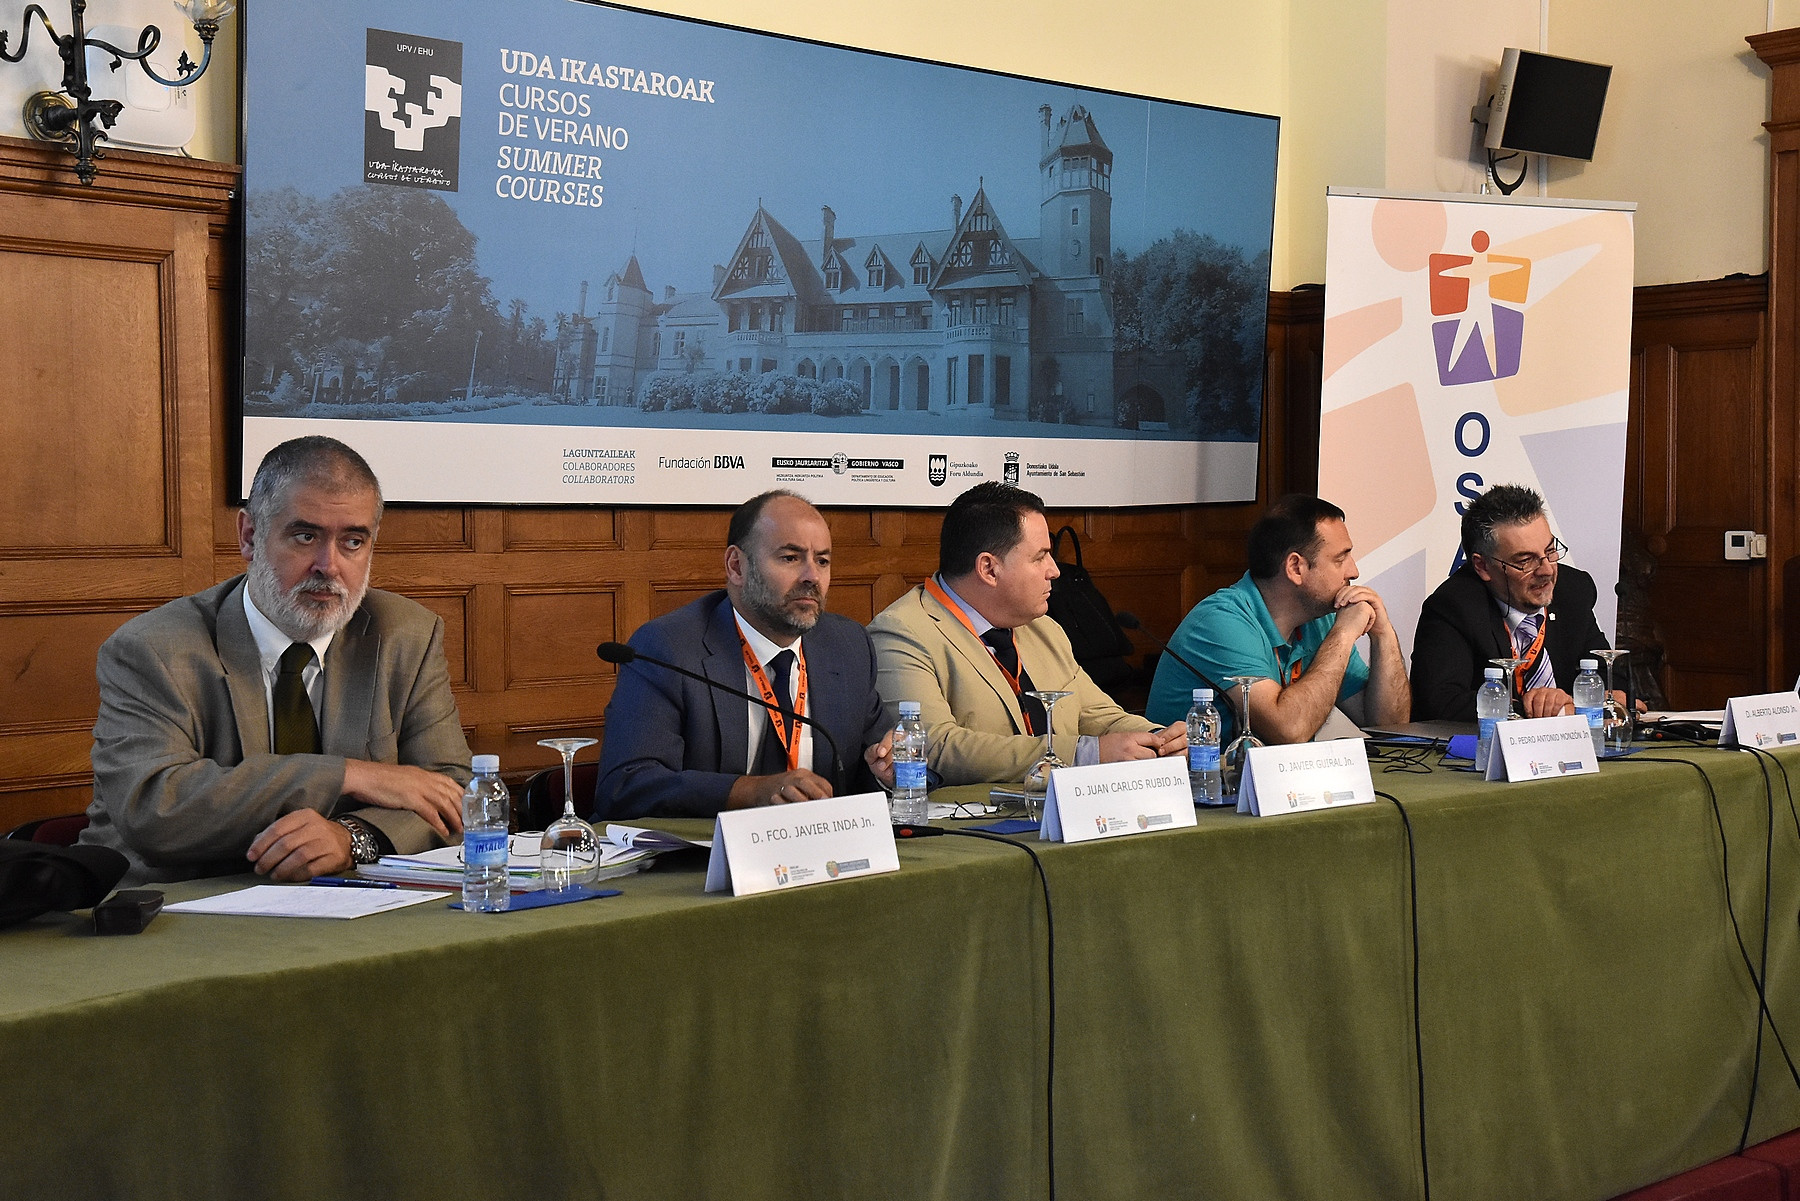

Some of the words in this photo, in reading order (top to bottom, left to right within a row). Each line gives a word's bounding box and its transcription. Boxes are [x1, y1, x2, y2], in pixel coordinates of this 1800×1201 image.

[396, 44, 412, 54] UPV
[417, 46, 435, 57] EHU
[501, 48, 556, 80] UDA
[560, 58, 715, 103] IKASTAROAK
[499, 83, 591, 117] CURSOS
[1496, 84, 1507, 112] BOSCH
[498, 112, 530, 138] DE
[534, 116, 629, 150] VERANO
[497, 146, 602, 180] SUMMER
[496, 175, 604, 208] COURSES
[562, 449, 636, 459] LAGUNTZAILEAK
[562, 462, 636, 472] COLABORADORES
[659, 456, 711, 469] Fundación
[713, 455, 745, 469] BBVA
[795, 459, 829, 467] JAURLARITZA
[882, 460, 899, 468] VASCO
[949, 461, 978, 470] Gipuzkoako
[562, 475, 636, 485] COLLABORATORS
[1518, 735, 1536, 745] PEDRO
[1536, 733, 1560, 743] ANTONIO
[1560, 730, 1582, 741] MONZÓN
[1278, 763, 1287, 773] D.
[1289, 760, 1314, 772] JAVIER
[1316, 758, 1342, 769] GUIRAL
[1074, 786, 1084, 797] D.
[1087, 785, 1109, 796] JUAN
[1110, 779, 1144, 793] CARLOS
[1145, 776, 1172, 789] RUBIO
[751, 832, 764, 844] D.
[766, 828, 792, 842] FCO.
[795, 822, 830, 838] JAVIER
[833, 818, 858, 833] INDA
[861, 817, 875, 829] Jn.
